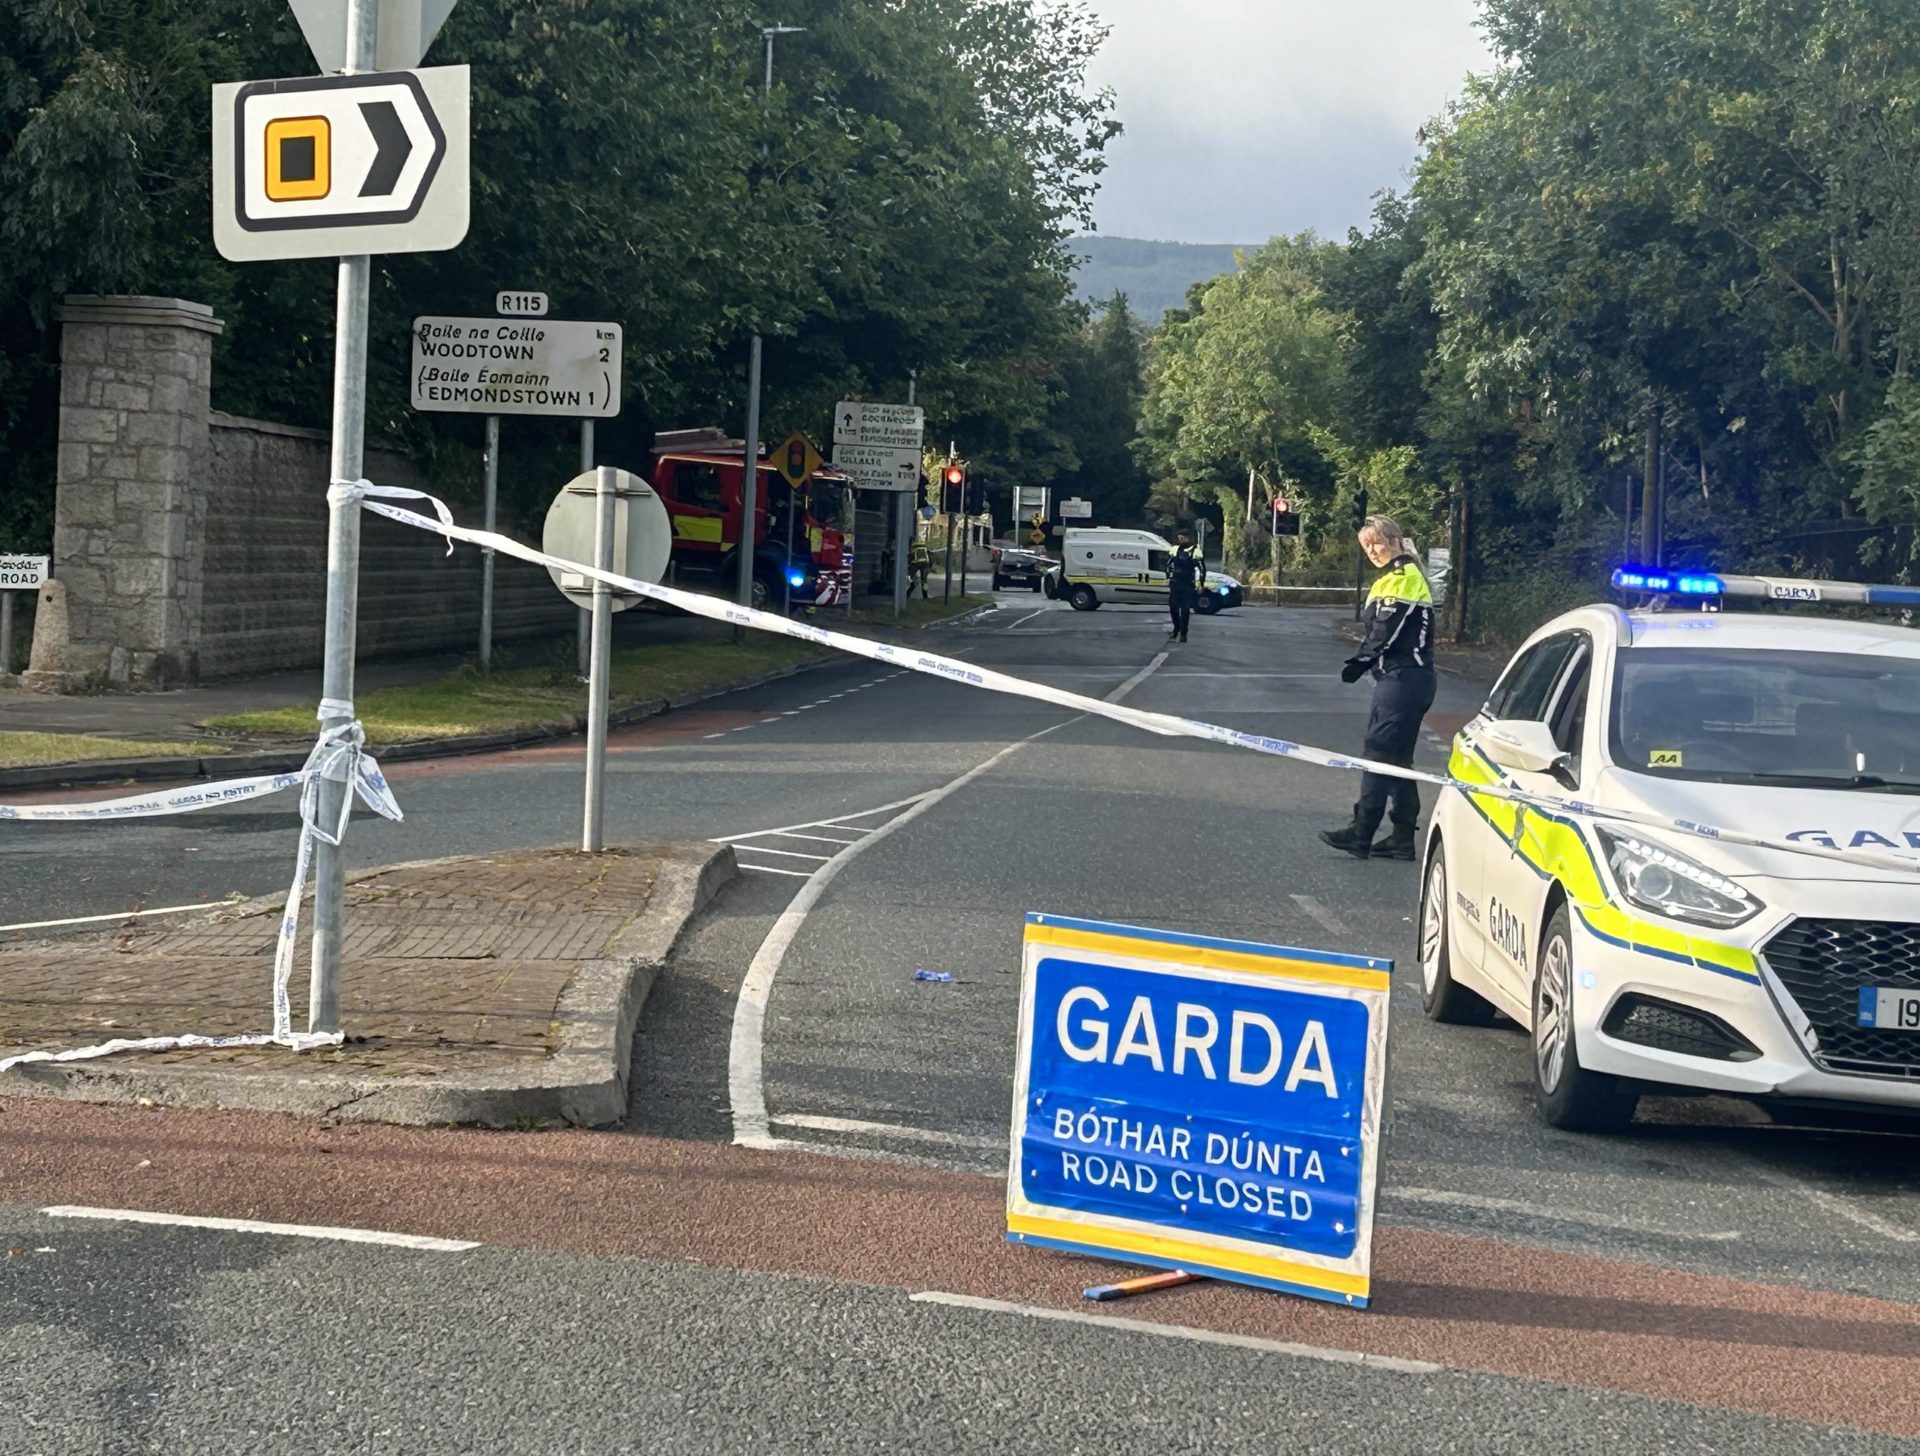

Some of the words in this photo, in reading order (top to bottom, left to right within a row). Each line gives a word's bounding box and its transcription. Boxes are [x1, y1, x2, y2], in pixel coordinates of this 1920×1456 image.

[421, 323, 462, 340] Baile
[468, 328, 490, 340] na
[497, 326, 545, 342] Coille
[596, 329, 615, 340] km
[421, 342, 534, 361] WOODTOWN
[599, 347, 609, 363] 2
[427, 367, 470, 383] Baile
[429, 386, 580, 406] EDMONDSTOWN
[588, 391, 594, 406] 1
[1, 573, 39, 584] ROAD
[1774, 586, 1817, 600] GARDA
[1654, 754, 1677, 763] AA
[1489, 895, 1528, 972] GARDA
[1056, 985, 1339, 1100] GARDA
[1054, 1106, 1192, 1160] BÓTHAR
[1205, 1132, 1326, 1184] DÚNTA
[1062, 1151, 1158, 1194] ROAD
[1171, 1170, 1313, 1222] CLOSED
